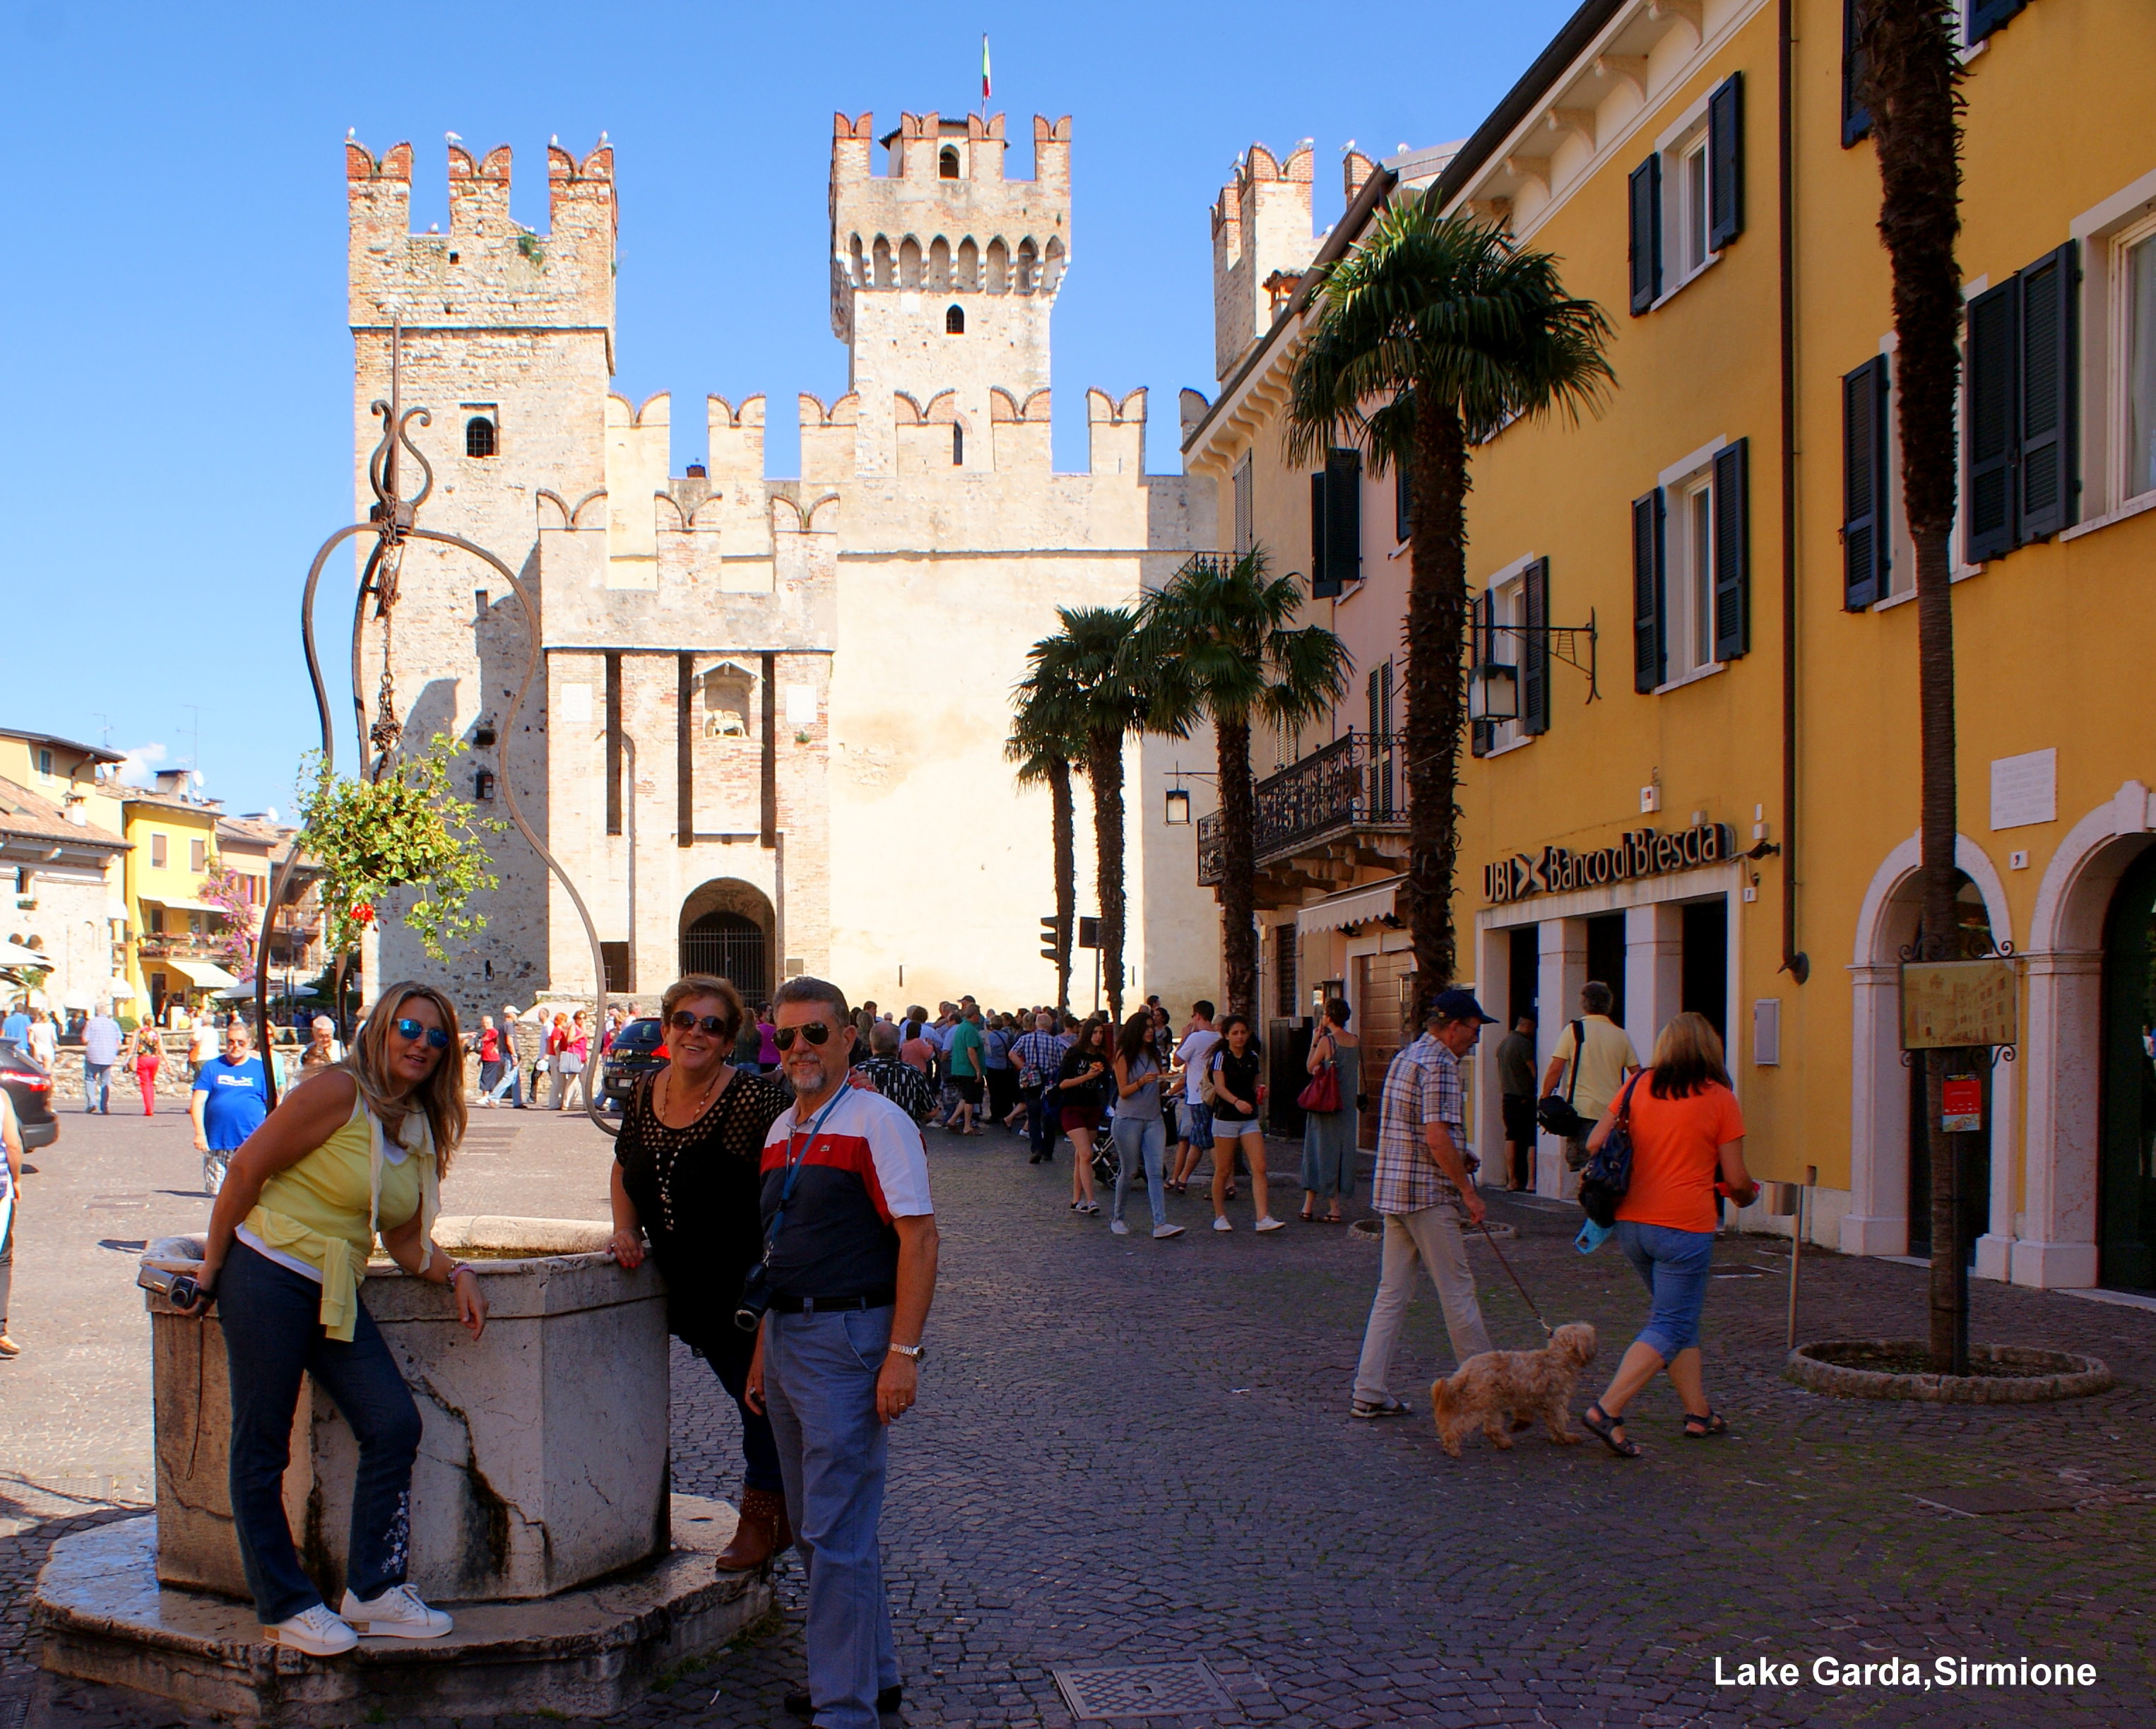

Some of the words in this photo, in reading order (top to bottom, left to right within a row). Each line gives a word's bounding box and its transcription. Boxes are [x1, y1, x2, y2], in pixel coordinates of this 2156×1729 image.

[1483, 858, 1516, 903] UBI
[1550, 849, 1611, 891] Banco
[1612, 832, 1633, 878] di
[1634, 824, 1719, 875] Brescia
